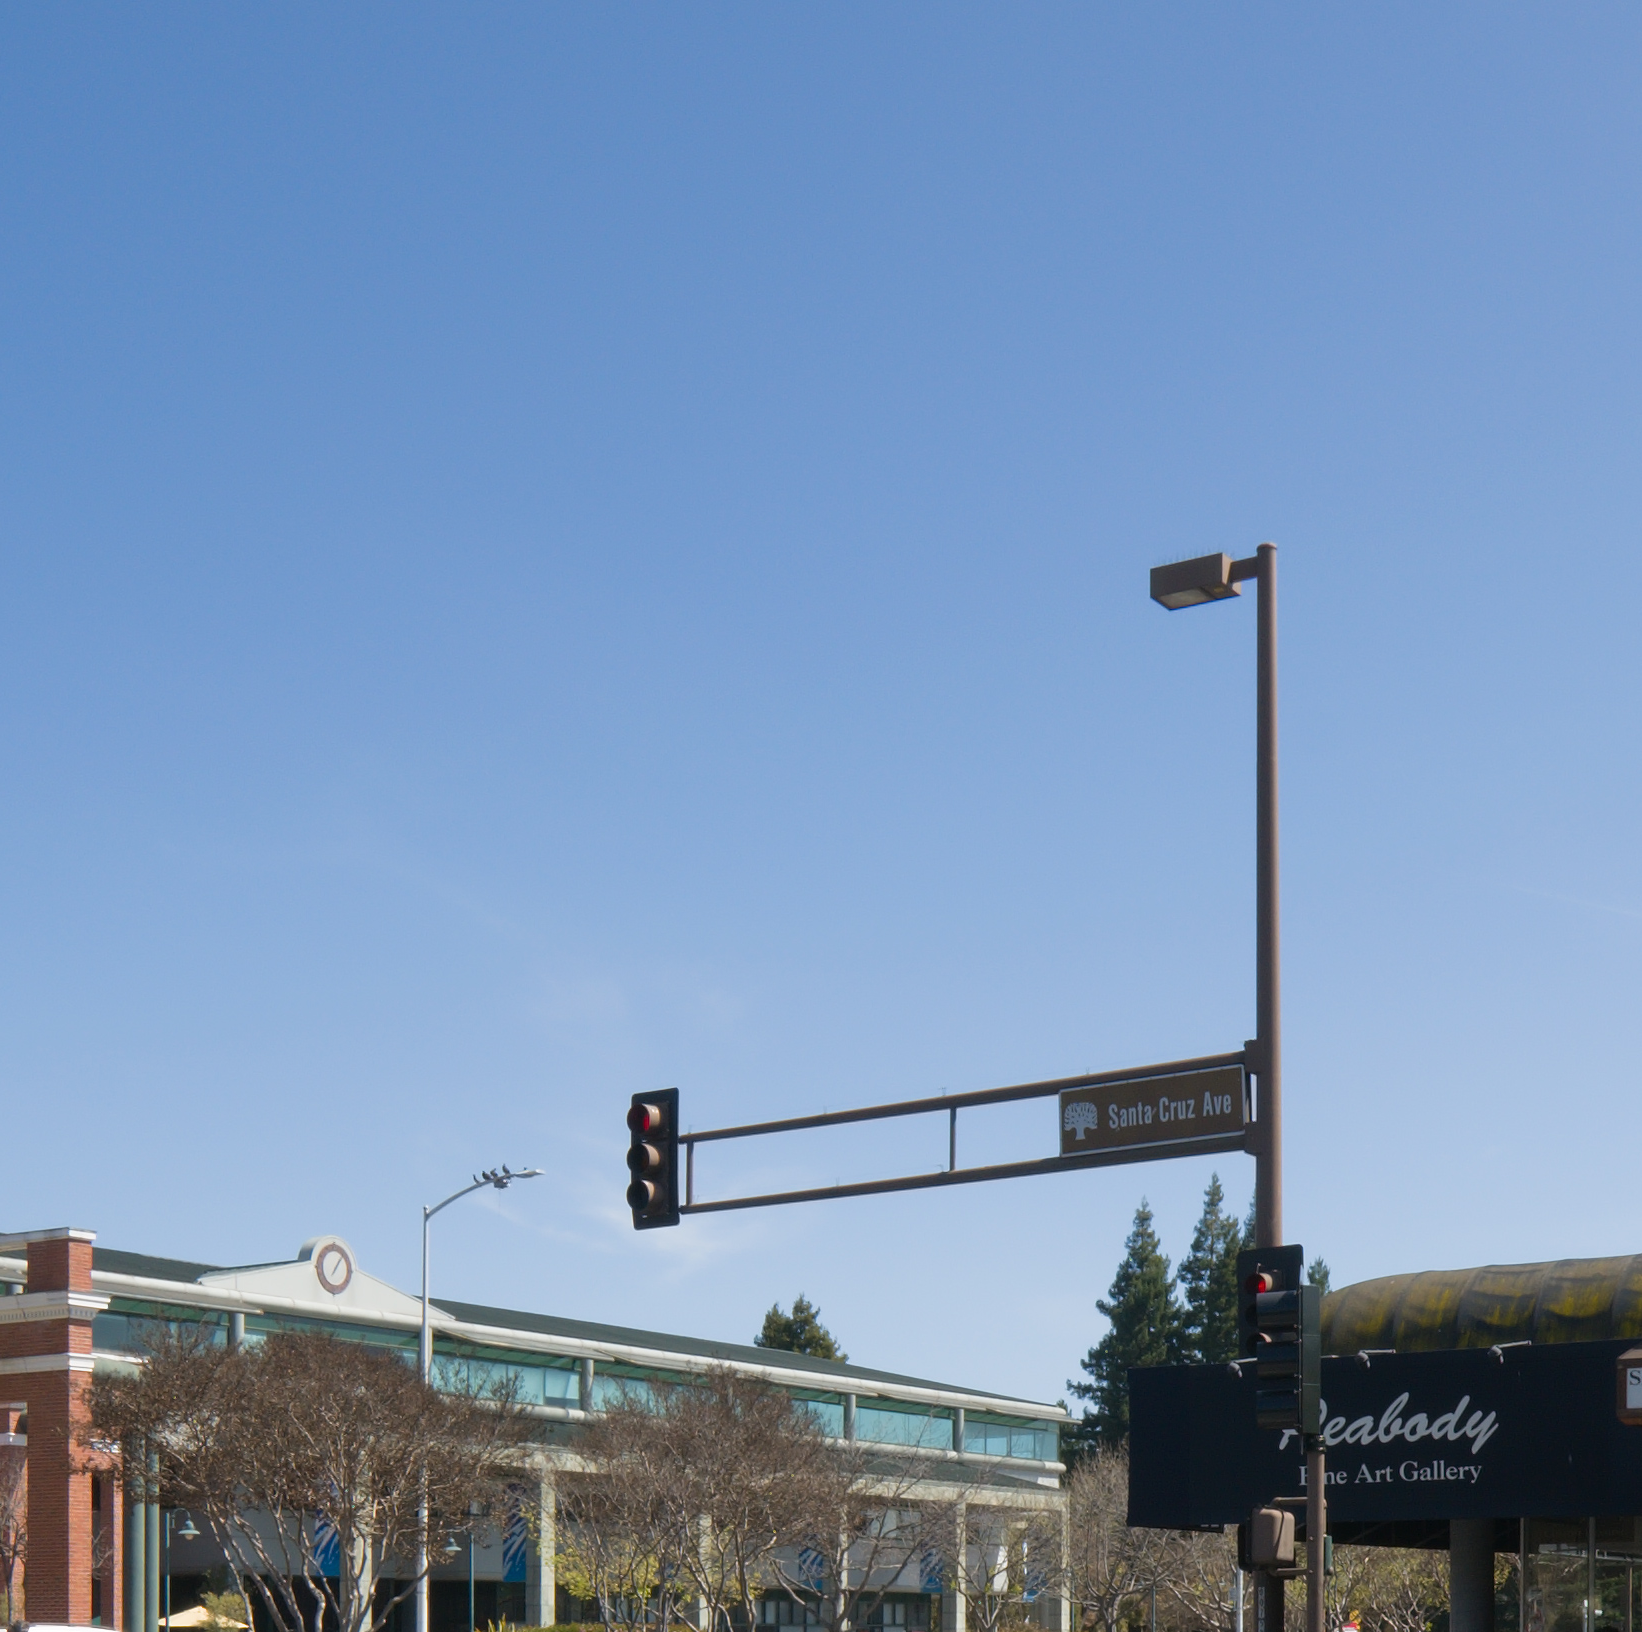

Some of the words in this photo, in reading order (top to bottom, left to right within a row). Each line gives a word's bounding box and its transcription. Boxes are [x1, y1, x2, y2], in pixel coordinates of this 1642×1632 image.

[1108, 1102, 1154, 1129] Santa
[1159, 1096, 1196, 1122] Cruz
[1203, 1091, 1233, 1117] Ave
[1354, 1463, 1393, 1483] Art
[1399, 1460, 1483, 1484] Gallery
